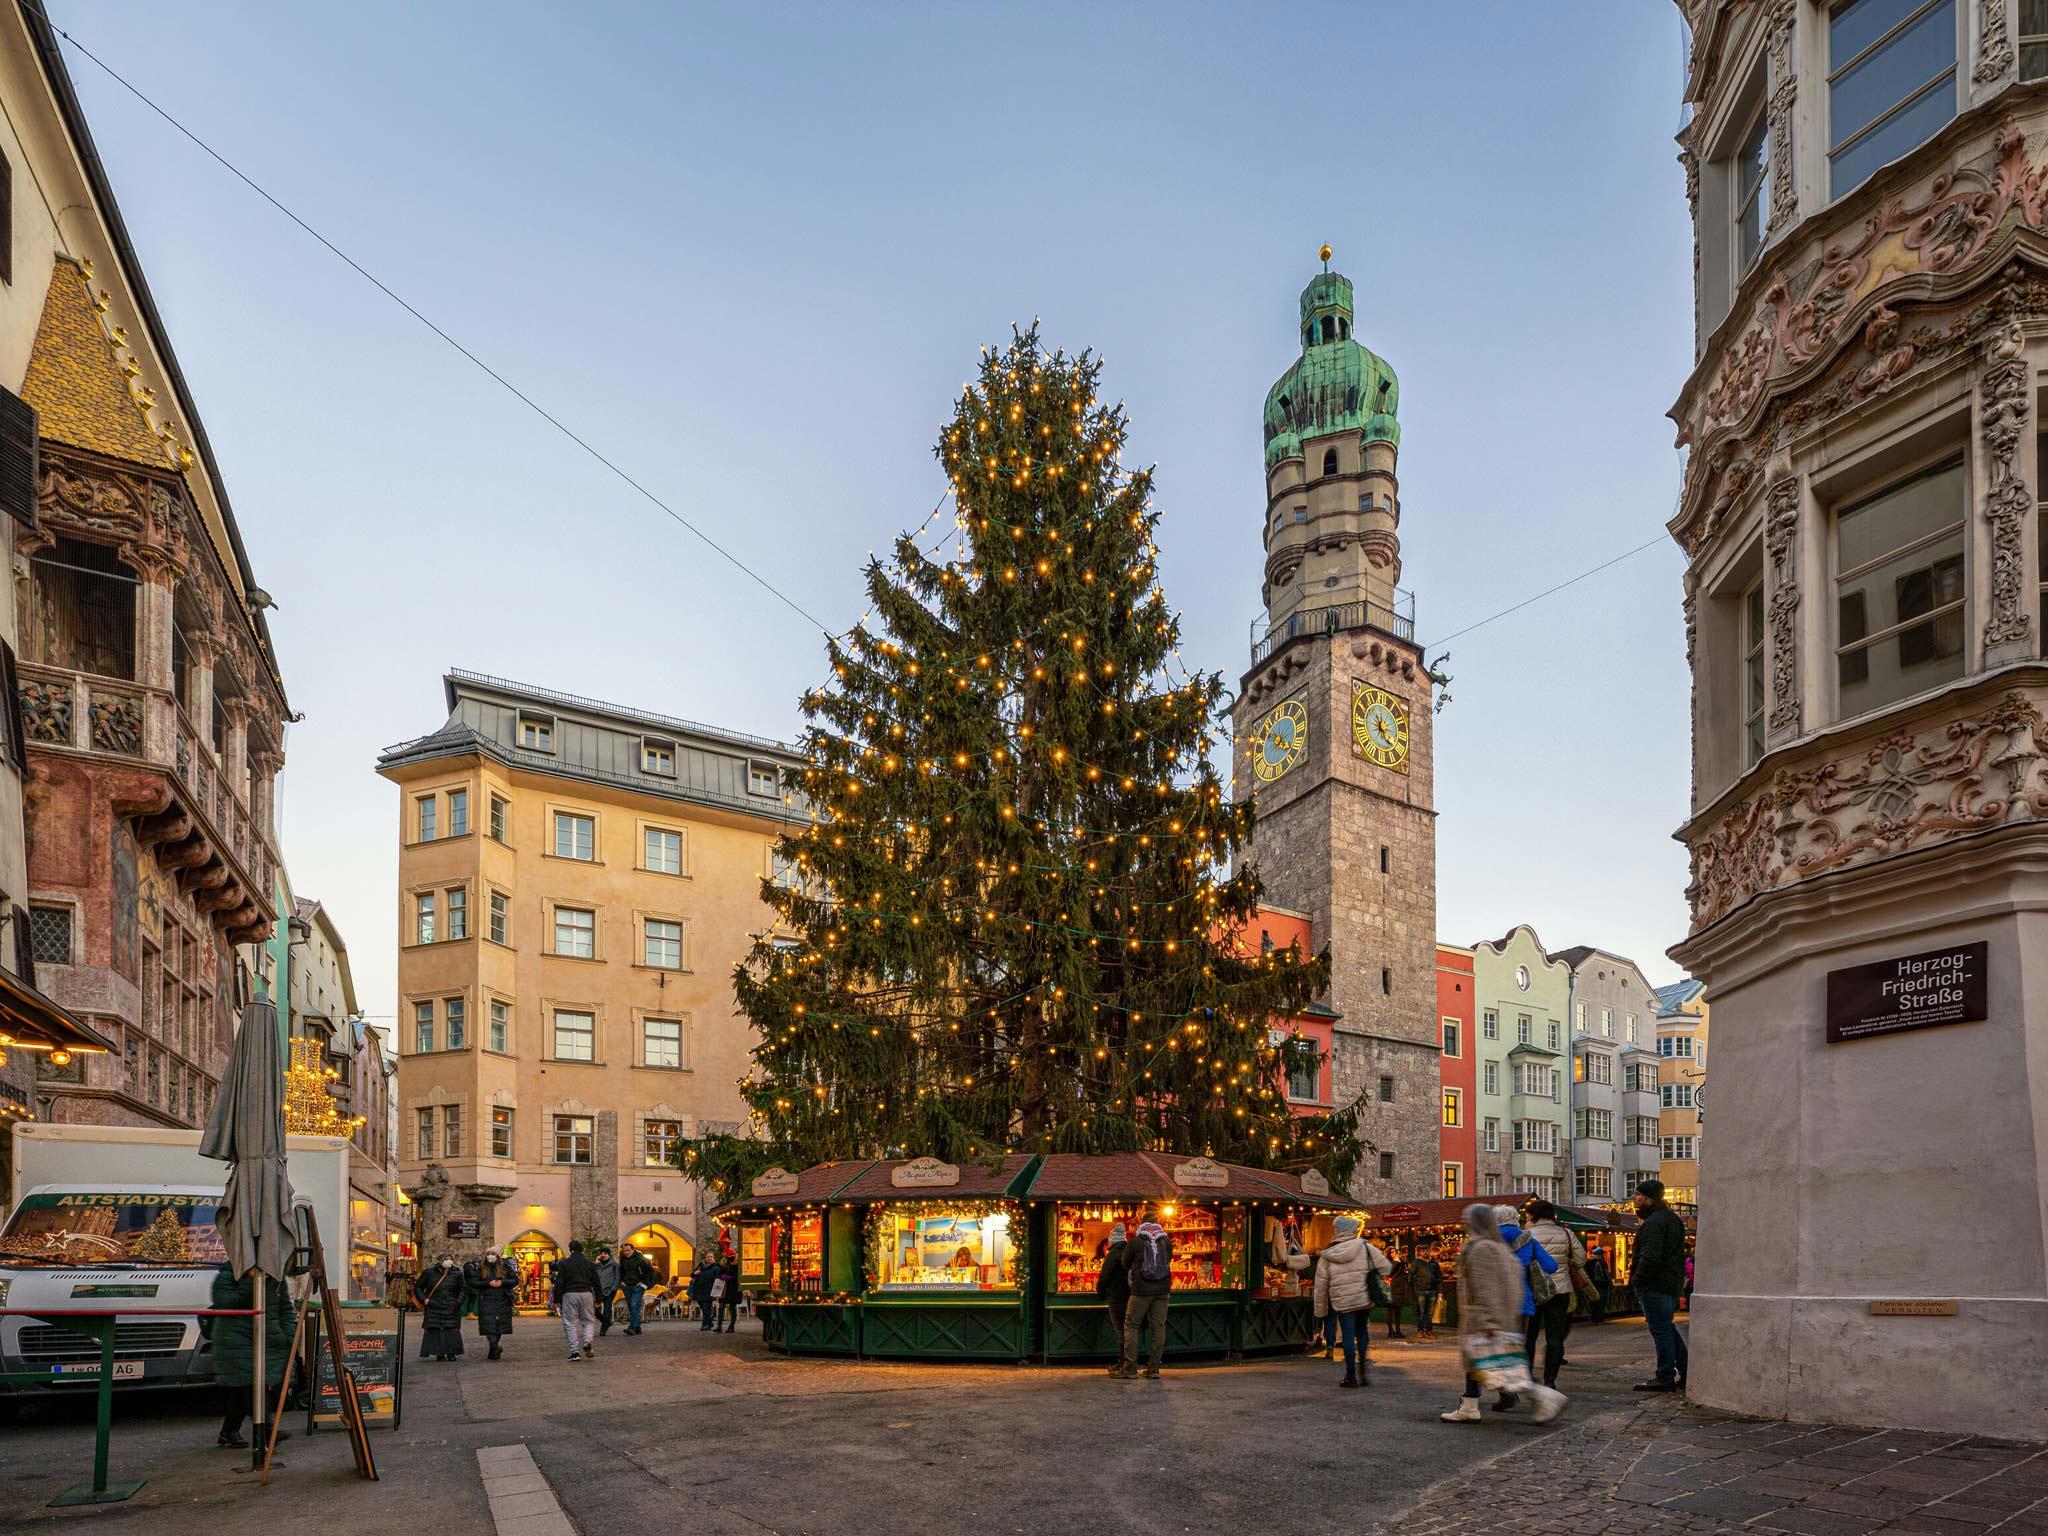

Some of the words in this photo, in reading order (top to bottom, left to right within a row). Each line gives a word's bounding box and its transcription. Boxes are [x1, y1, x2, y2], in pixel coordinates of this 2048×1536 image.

[1897, 952, 1973, 976] Herzog-
[1882, 969, 1973, 996] Friedrich-
[1899, 987, 1963, 1010] Straße
[115, 1364, 134, 1375] AG
